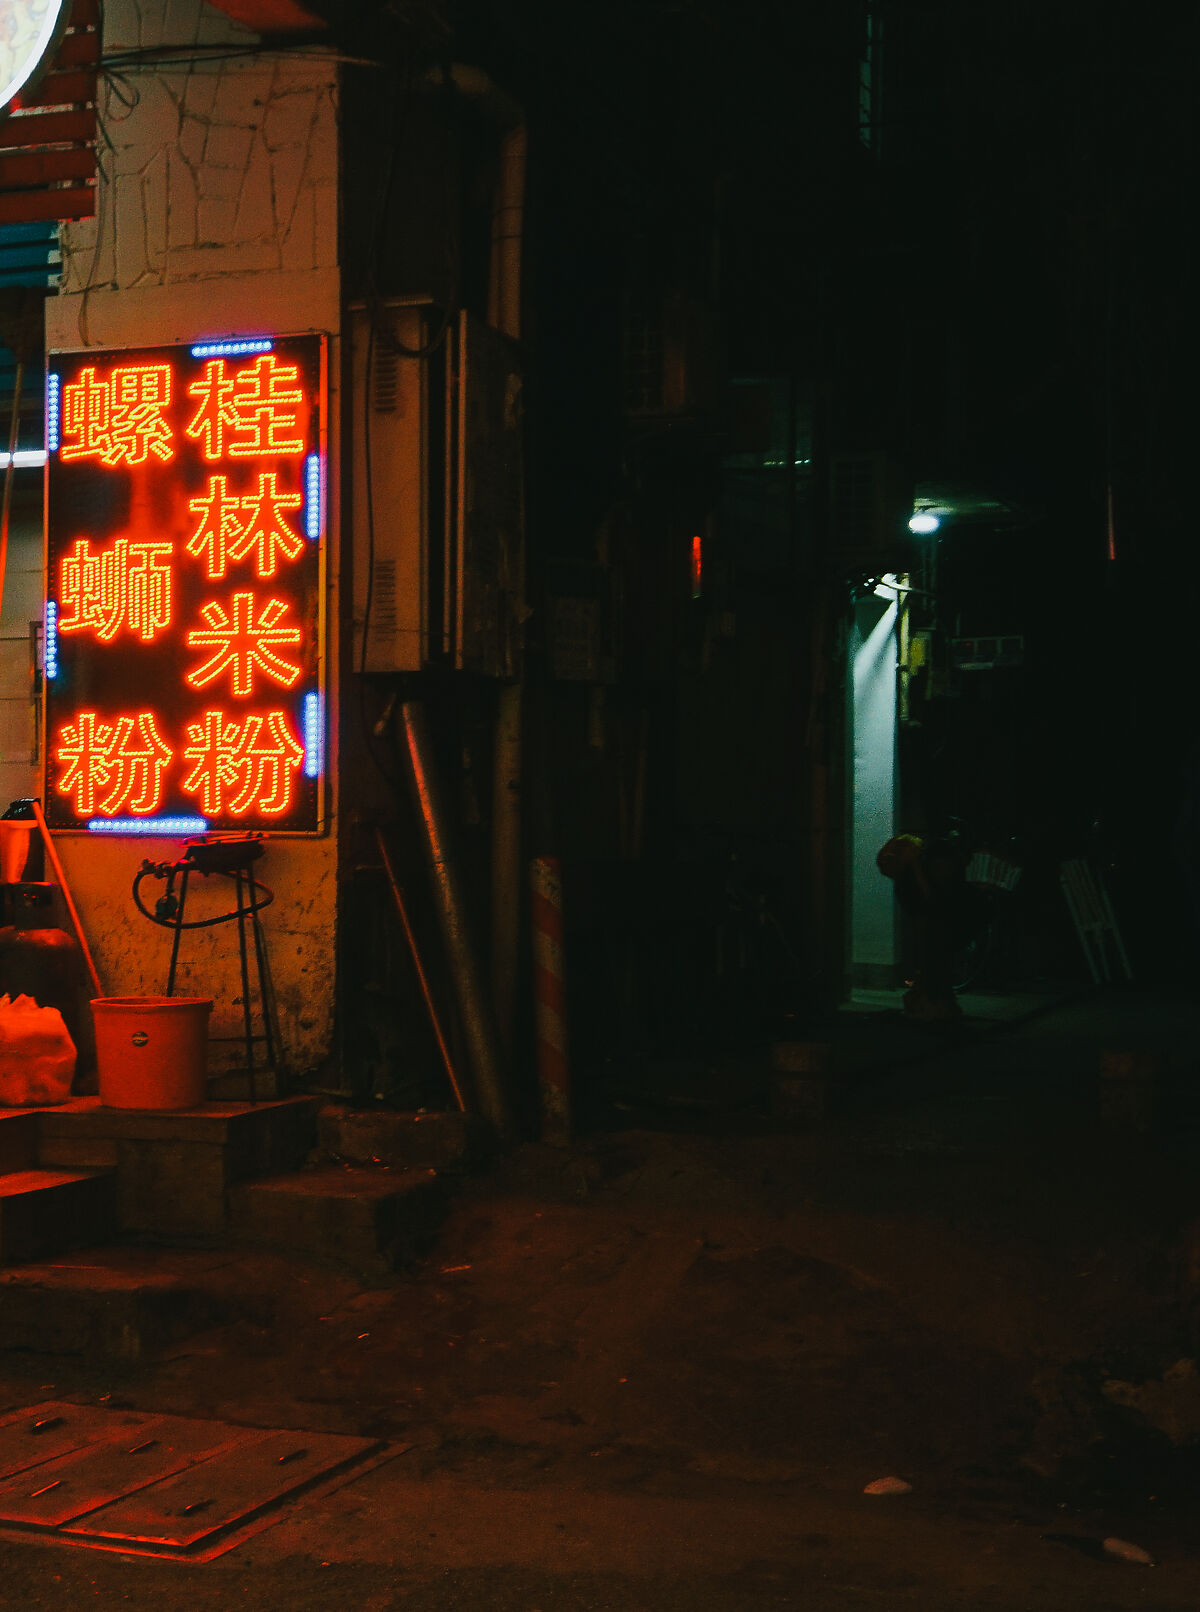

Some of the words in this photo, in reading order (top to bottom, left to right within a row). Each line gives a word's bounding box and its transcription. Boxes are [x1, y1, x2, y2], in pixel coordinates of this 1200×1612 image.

[56, 363, 175, 816] 螺蛳粉
[183, 355, 305, 816] 桂林米粉
